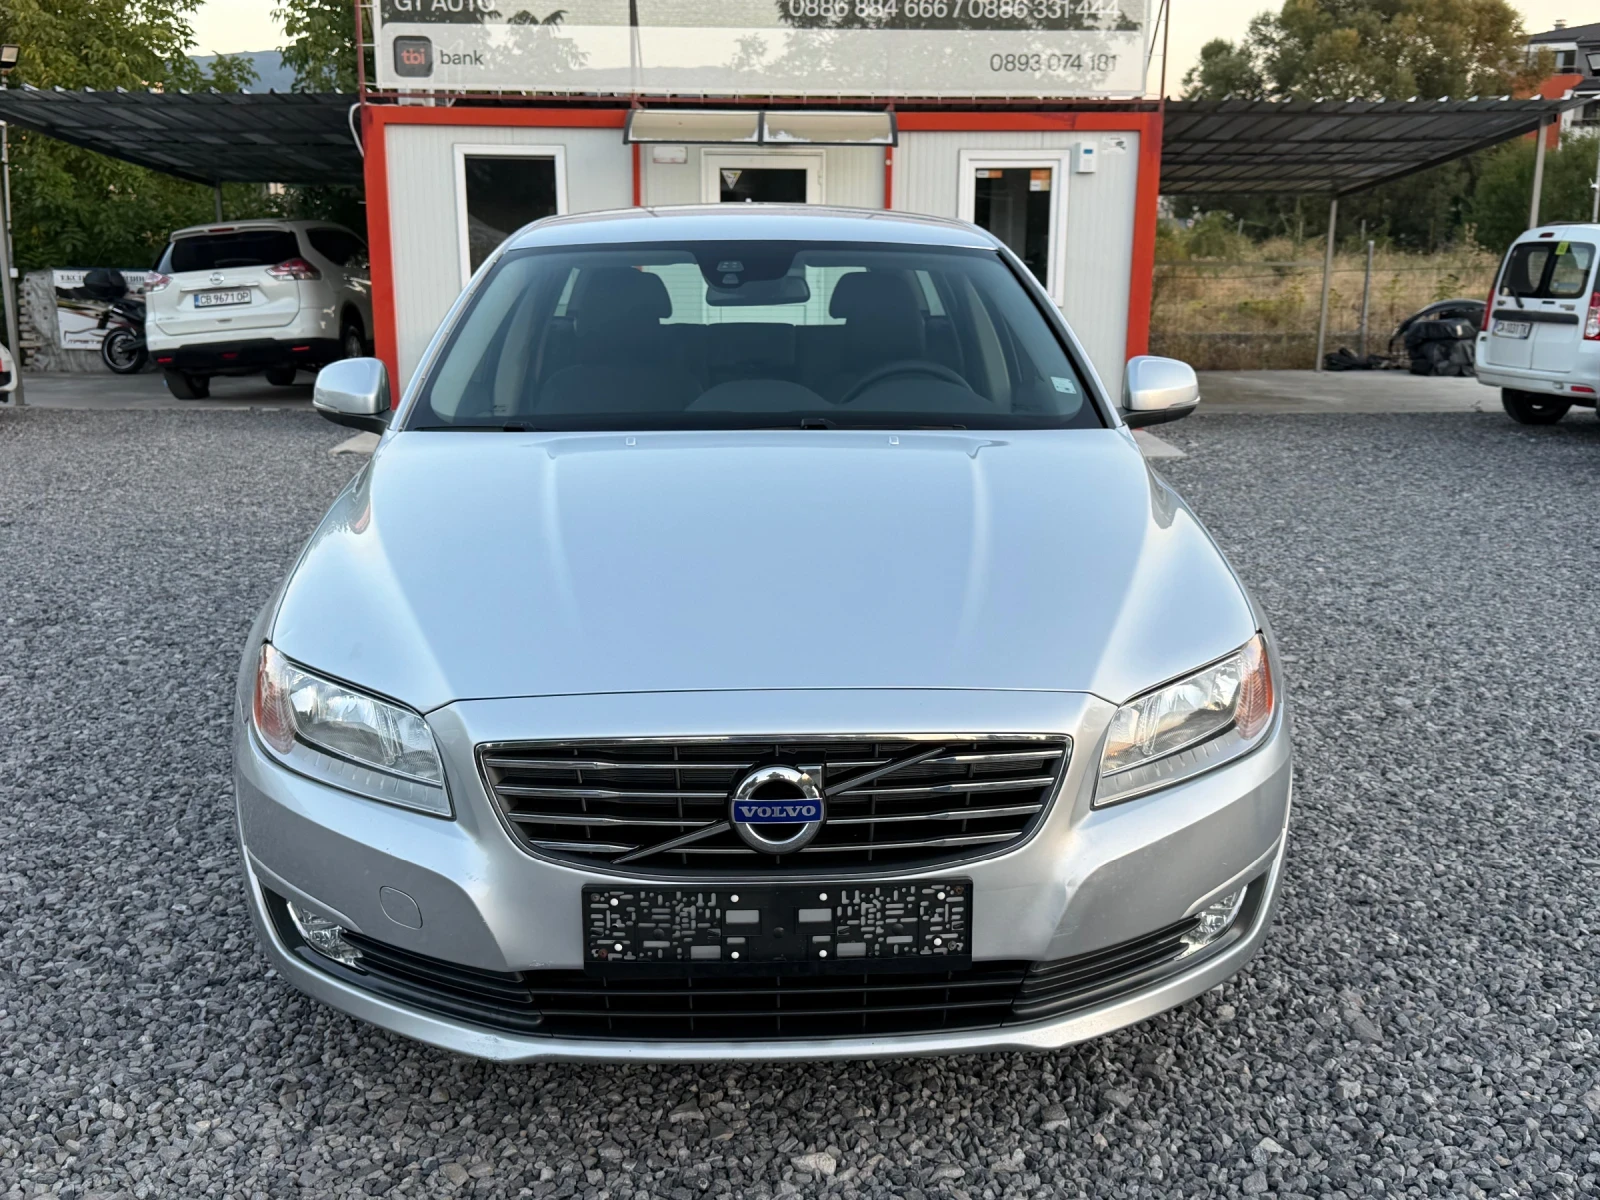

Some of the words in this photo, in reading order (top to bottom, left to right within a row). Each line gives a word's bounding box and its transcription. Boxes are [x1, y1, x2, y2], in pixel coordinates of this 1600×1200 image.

[431, 0, 496, 12] AUTO
[788, 0, 849, 17] 0886
[854, 0, 899, 18] 884
[903, 0, 948, 18] 666
[967, 0, 1029, 19] 0886
[1033, 0, 1070, 19] 331
[401, 47, 427, 65] tbi
[439, 49, 484, 66] bank
[989, 53, 1042, 72] 0893
[1047, 53, 1084, 72] 074
[739, 805, 816, 817] VOLVO
